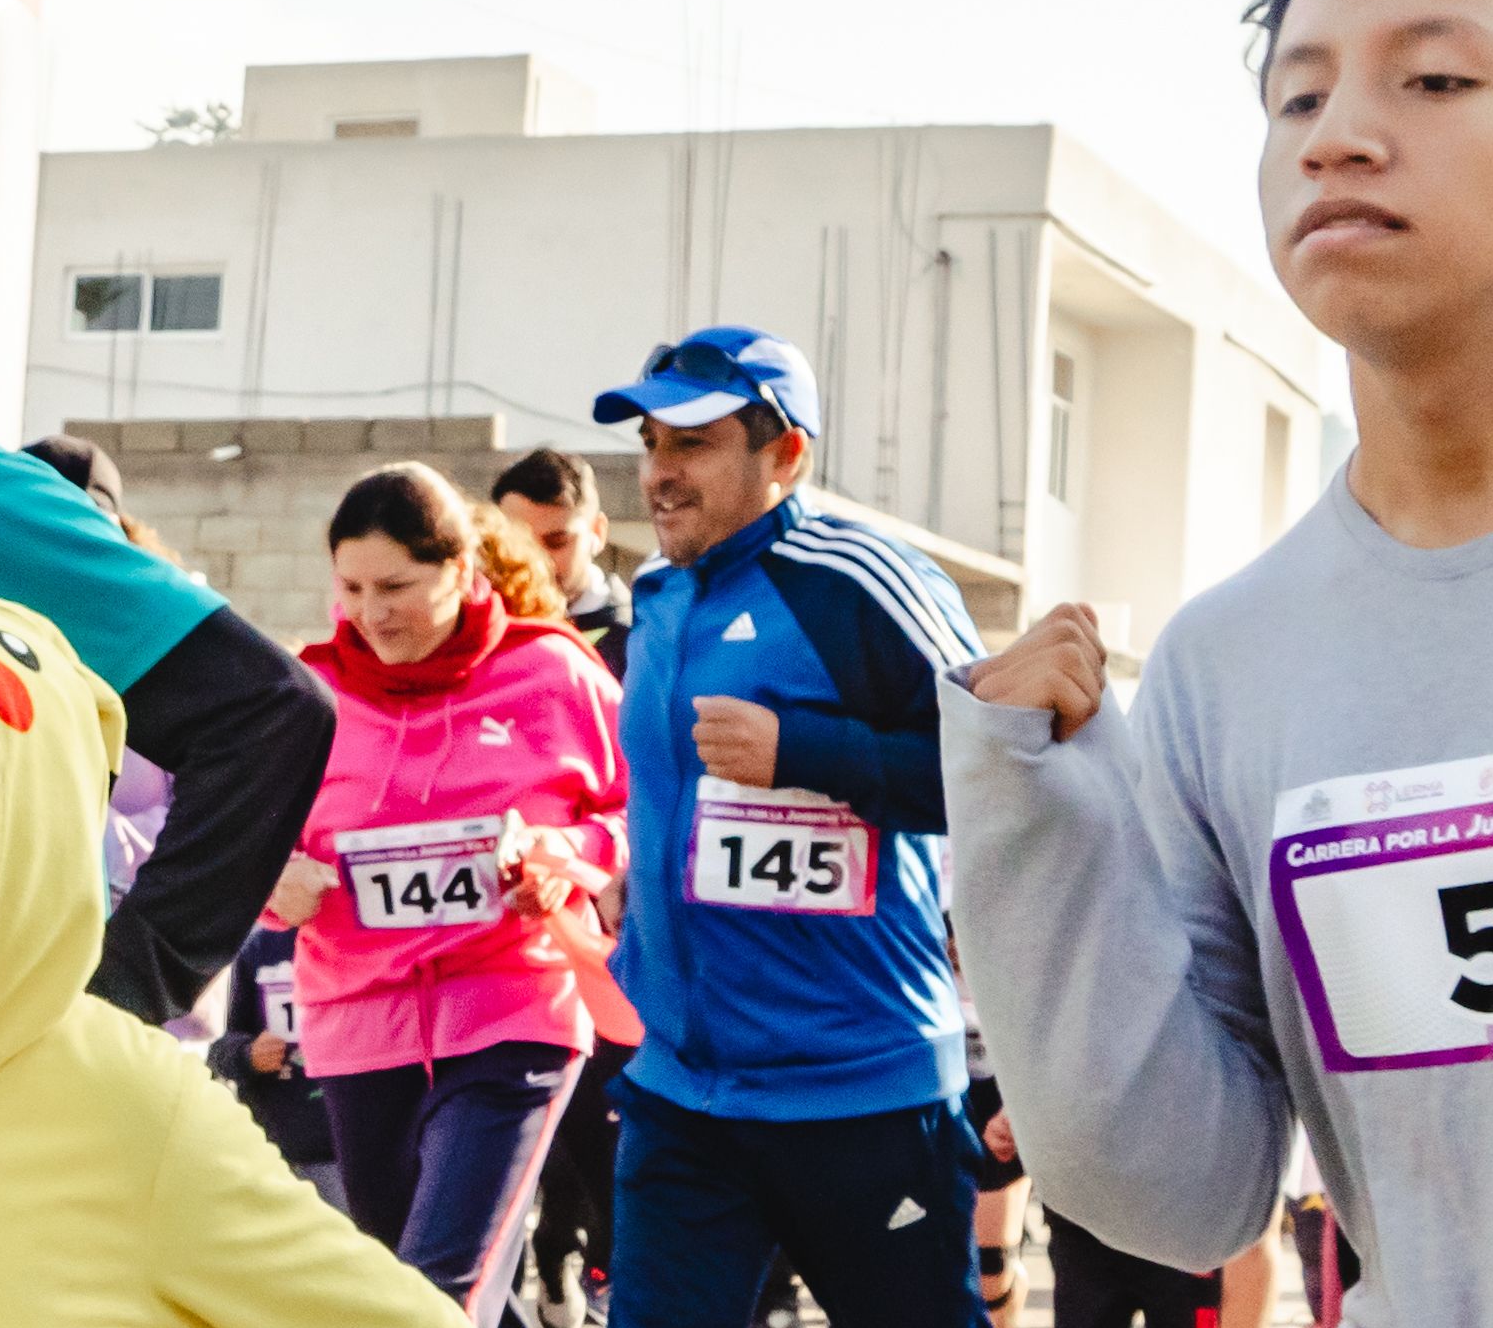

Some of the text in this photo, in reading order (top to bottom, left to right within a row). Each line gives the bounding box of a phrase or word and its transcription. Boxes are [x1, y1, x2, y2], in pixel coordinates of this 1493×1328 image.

[720, 836, 844, 894] 145
[1286, 836, 1382, 868] CARRERA
[1385, 828, 1428, 851] POR
[1432, 823, 1460, 844] LA
[370, 867, 482, 915] 144
